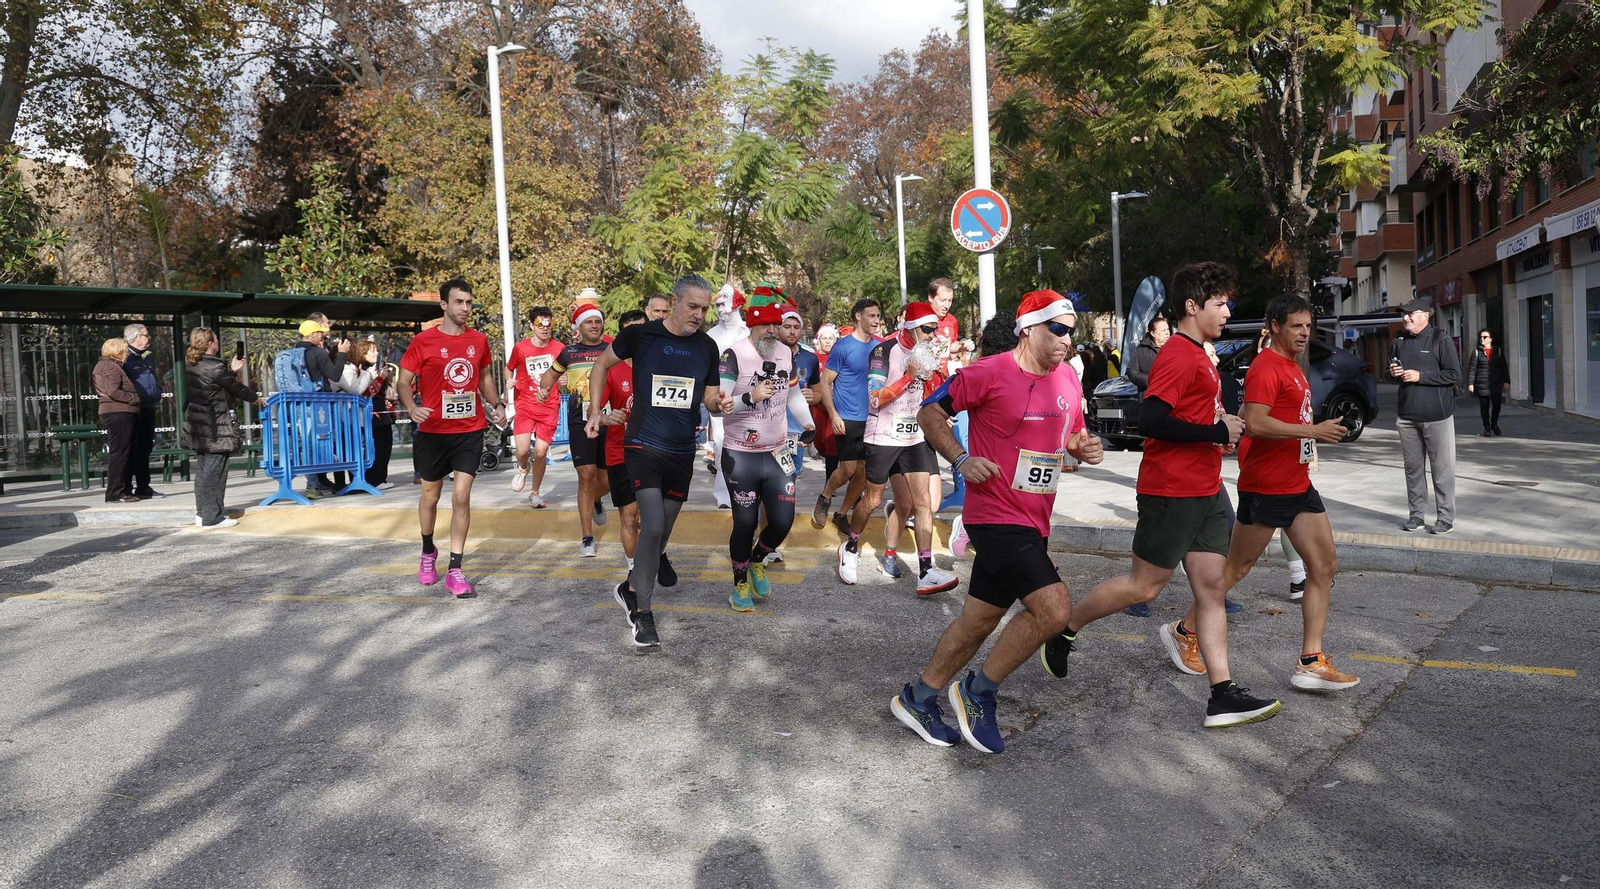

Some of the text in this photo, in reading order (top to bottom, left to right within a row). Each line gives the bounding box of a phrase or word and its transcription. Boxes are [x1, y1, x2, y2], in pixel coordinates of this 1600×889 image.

[954, 226, 1007, 250] EXCEPTO BUS
[529, 361, 550, 371] 319
[656, 387, 688, 400] 474
[446, 402, 472, 413] 255
[896, 423, 919, 433] 290
[1028, 467, 1053, 484] 95
